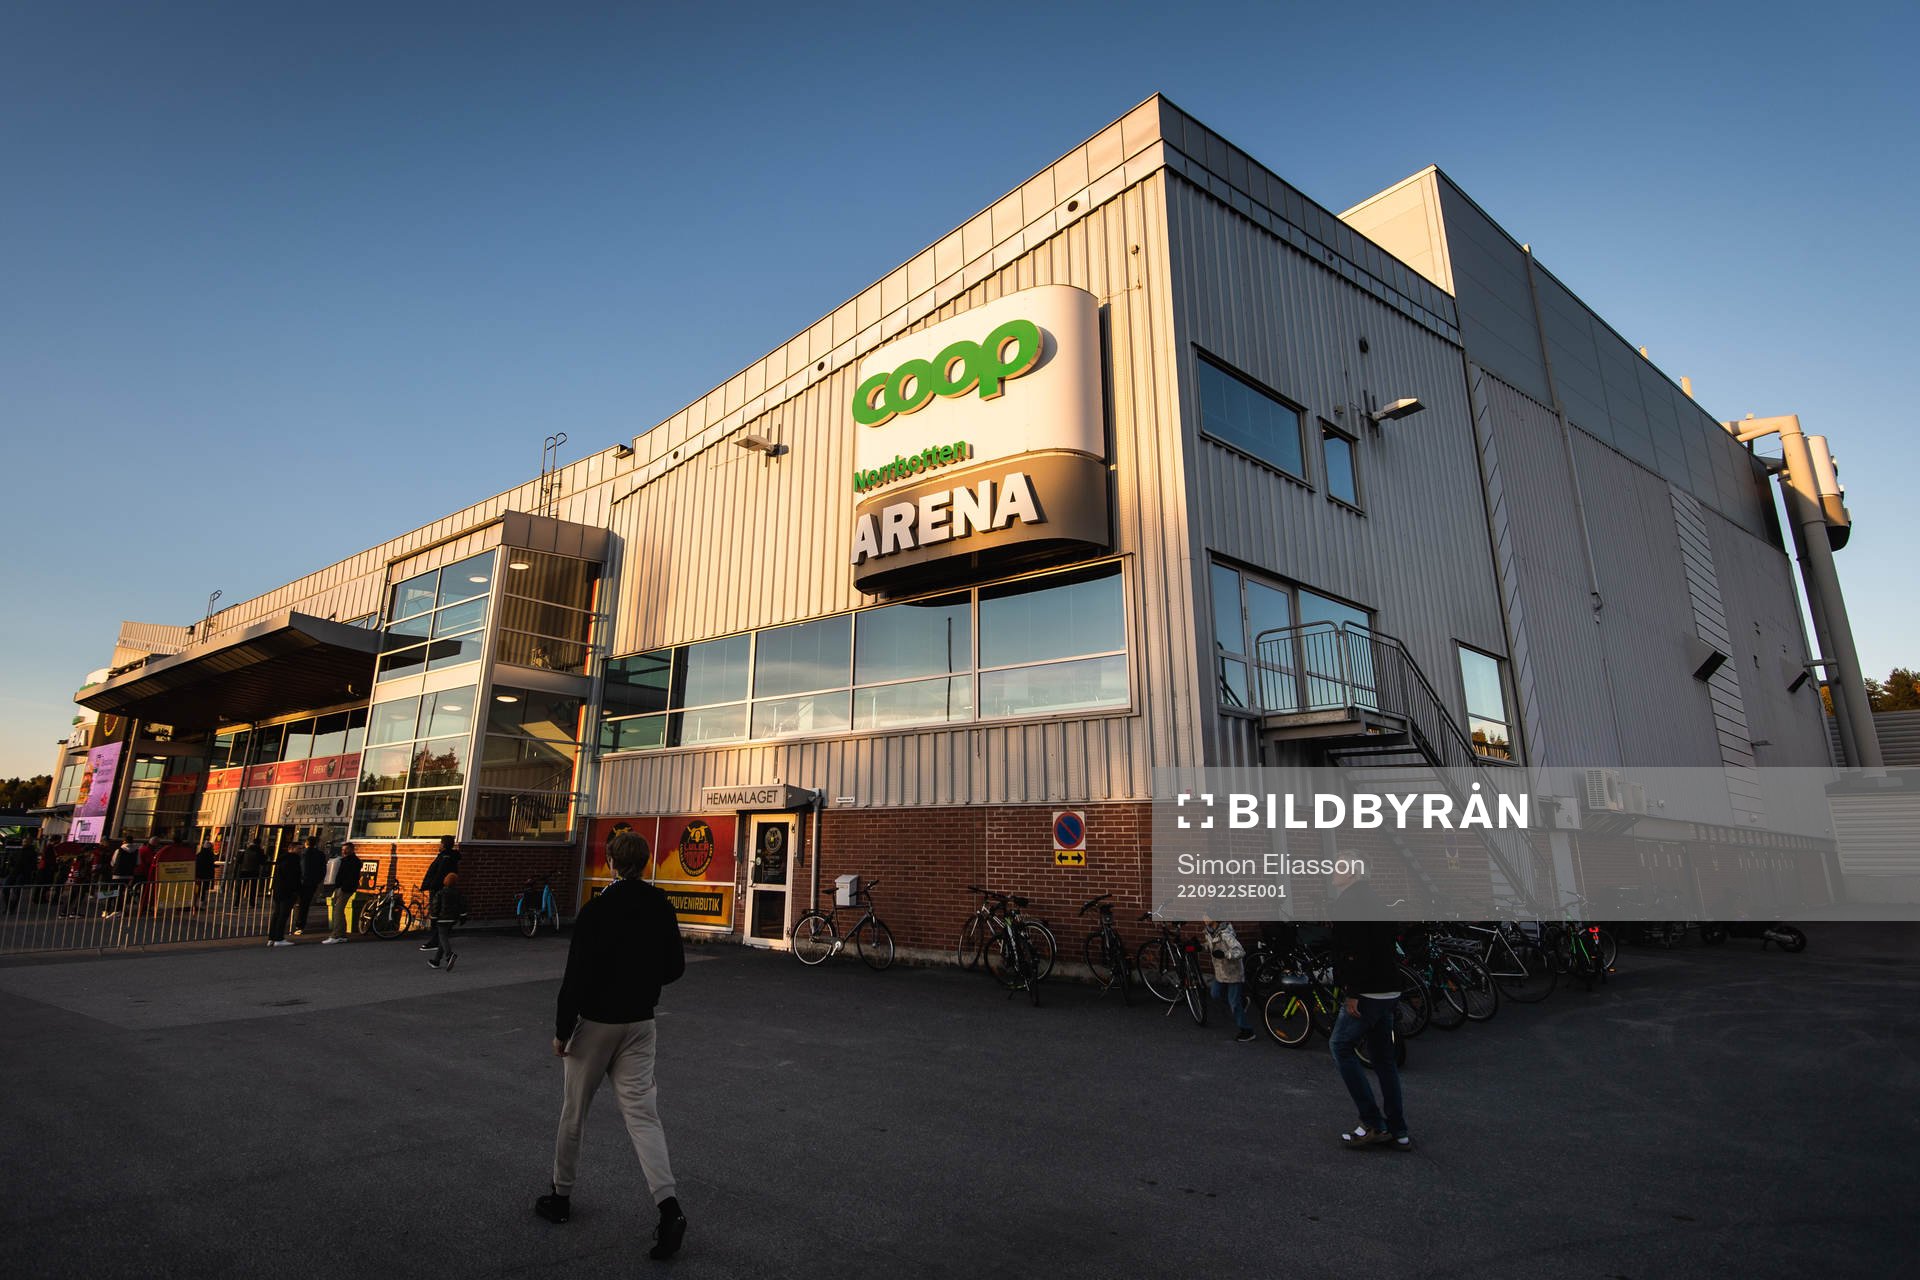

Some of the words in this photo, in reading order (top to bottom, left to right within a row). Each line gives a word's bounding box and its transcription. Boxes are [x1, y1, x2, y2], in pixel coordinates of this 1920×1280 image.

[852, 319, 1041, 425] coop
[854, 440, 968, 492] Norrbotten
[852, 472, 1040, 564] ARENA
[706, 790, 778, 805] HEMMALAGET
